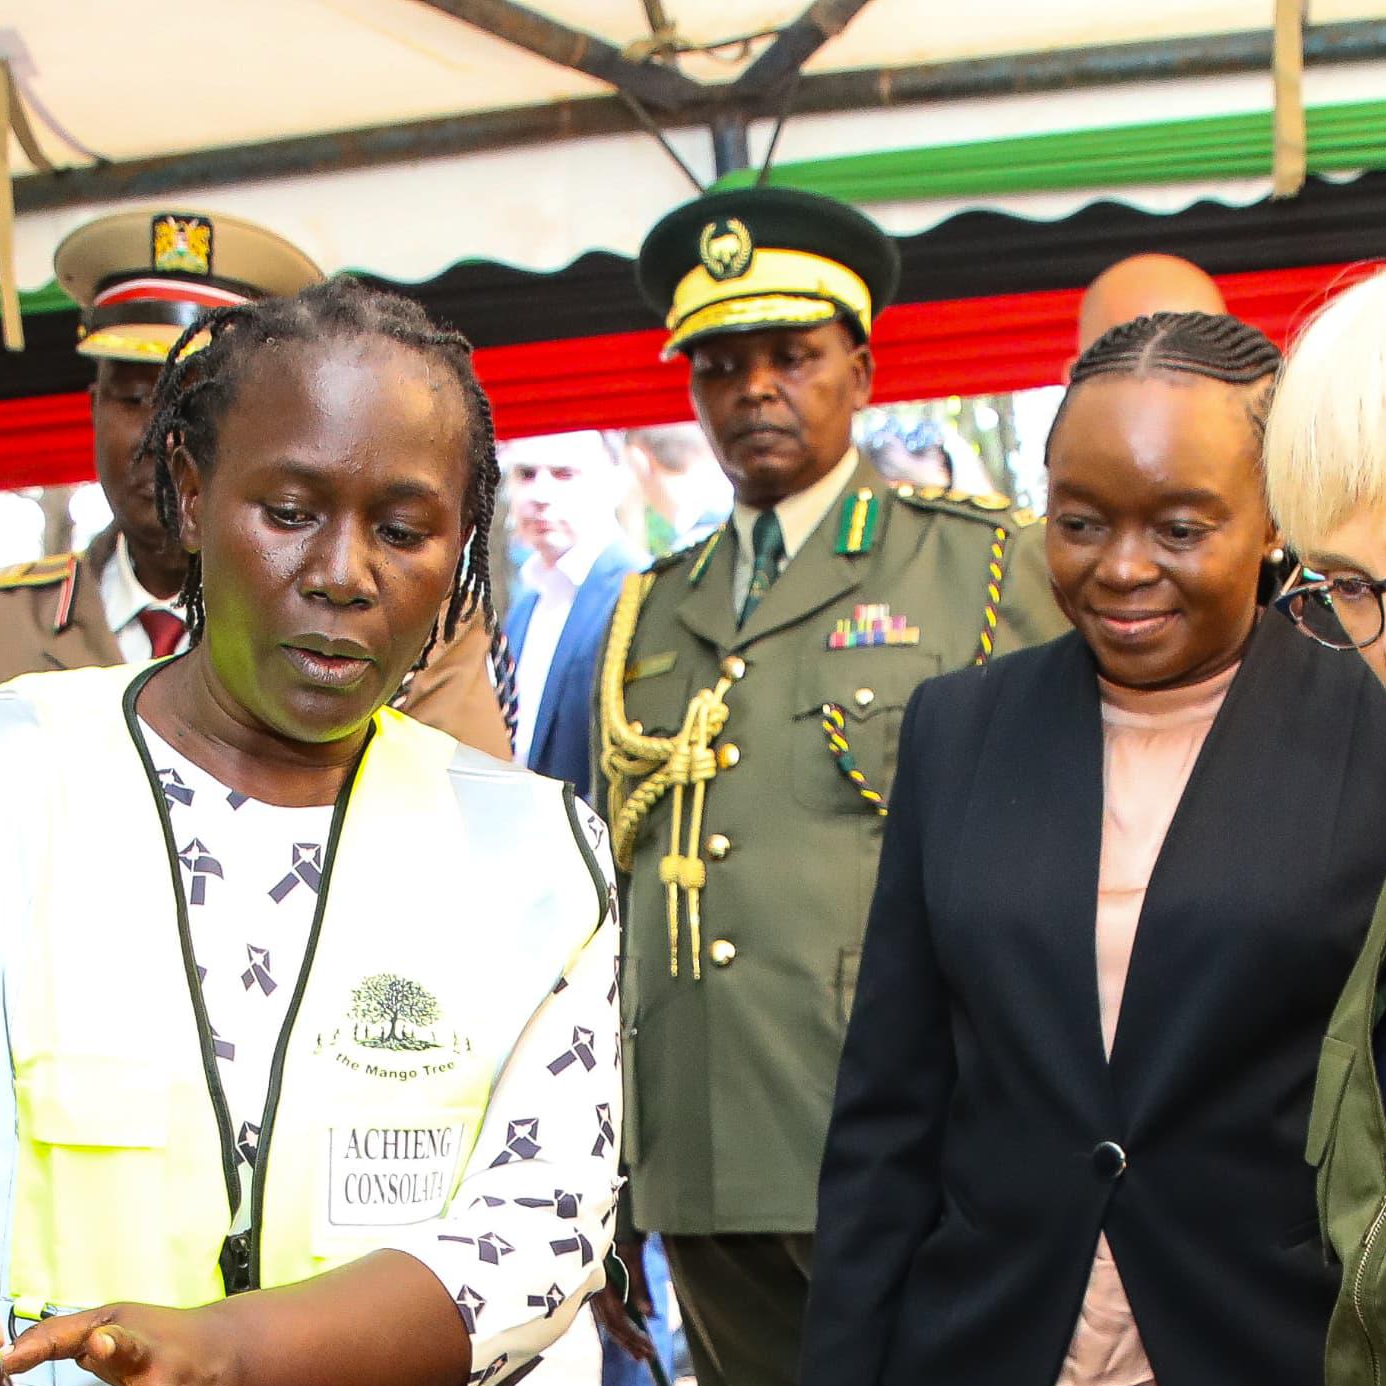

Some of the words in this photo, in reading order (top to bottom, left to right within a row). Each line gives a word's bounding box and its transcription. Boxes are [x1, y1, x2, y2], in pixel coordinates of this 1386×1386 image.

[335, 1052, 360, 1071] the
[365, 1064, 417, 1082] Mango
[422, 1061, 455, 1077] Tree
[344, 1126, 452, 1160] ACHIENG
